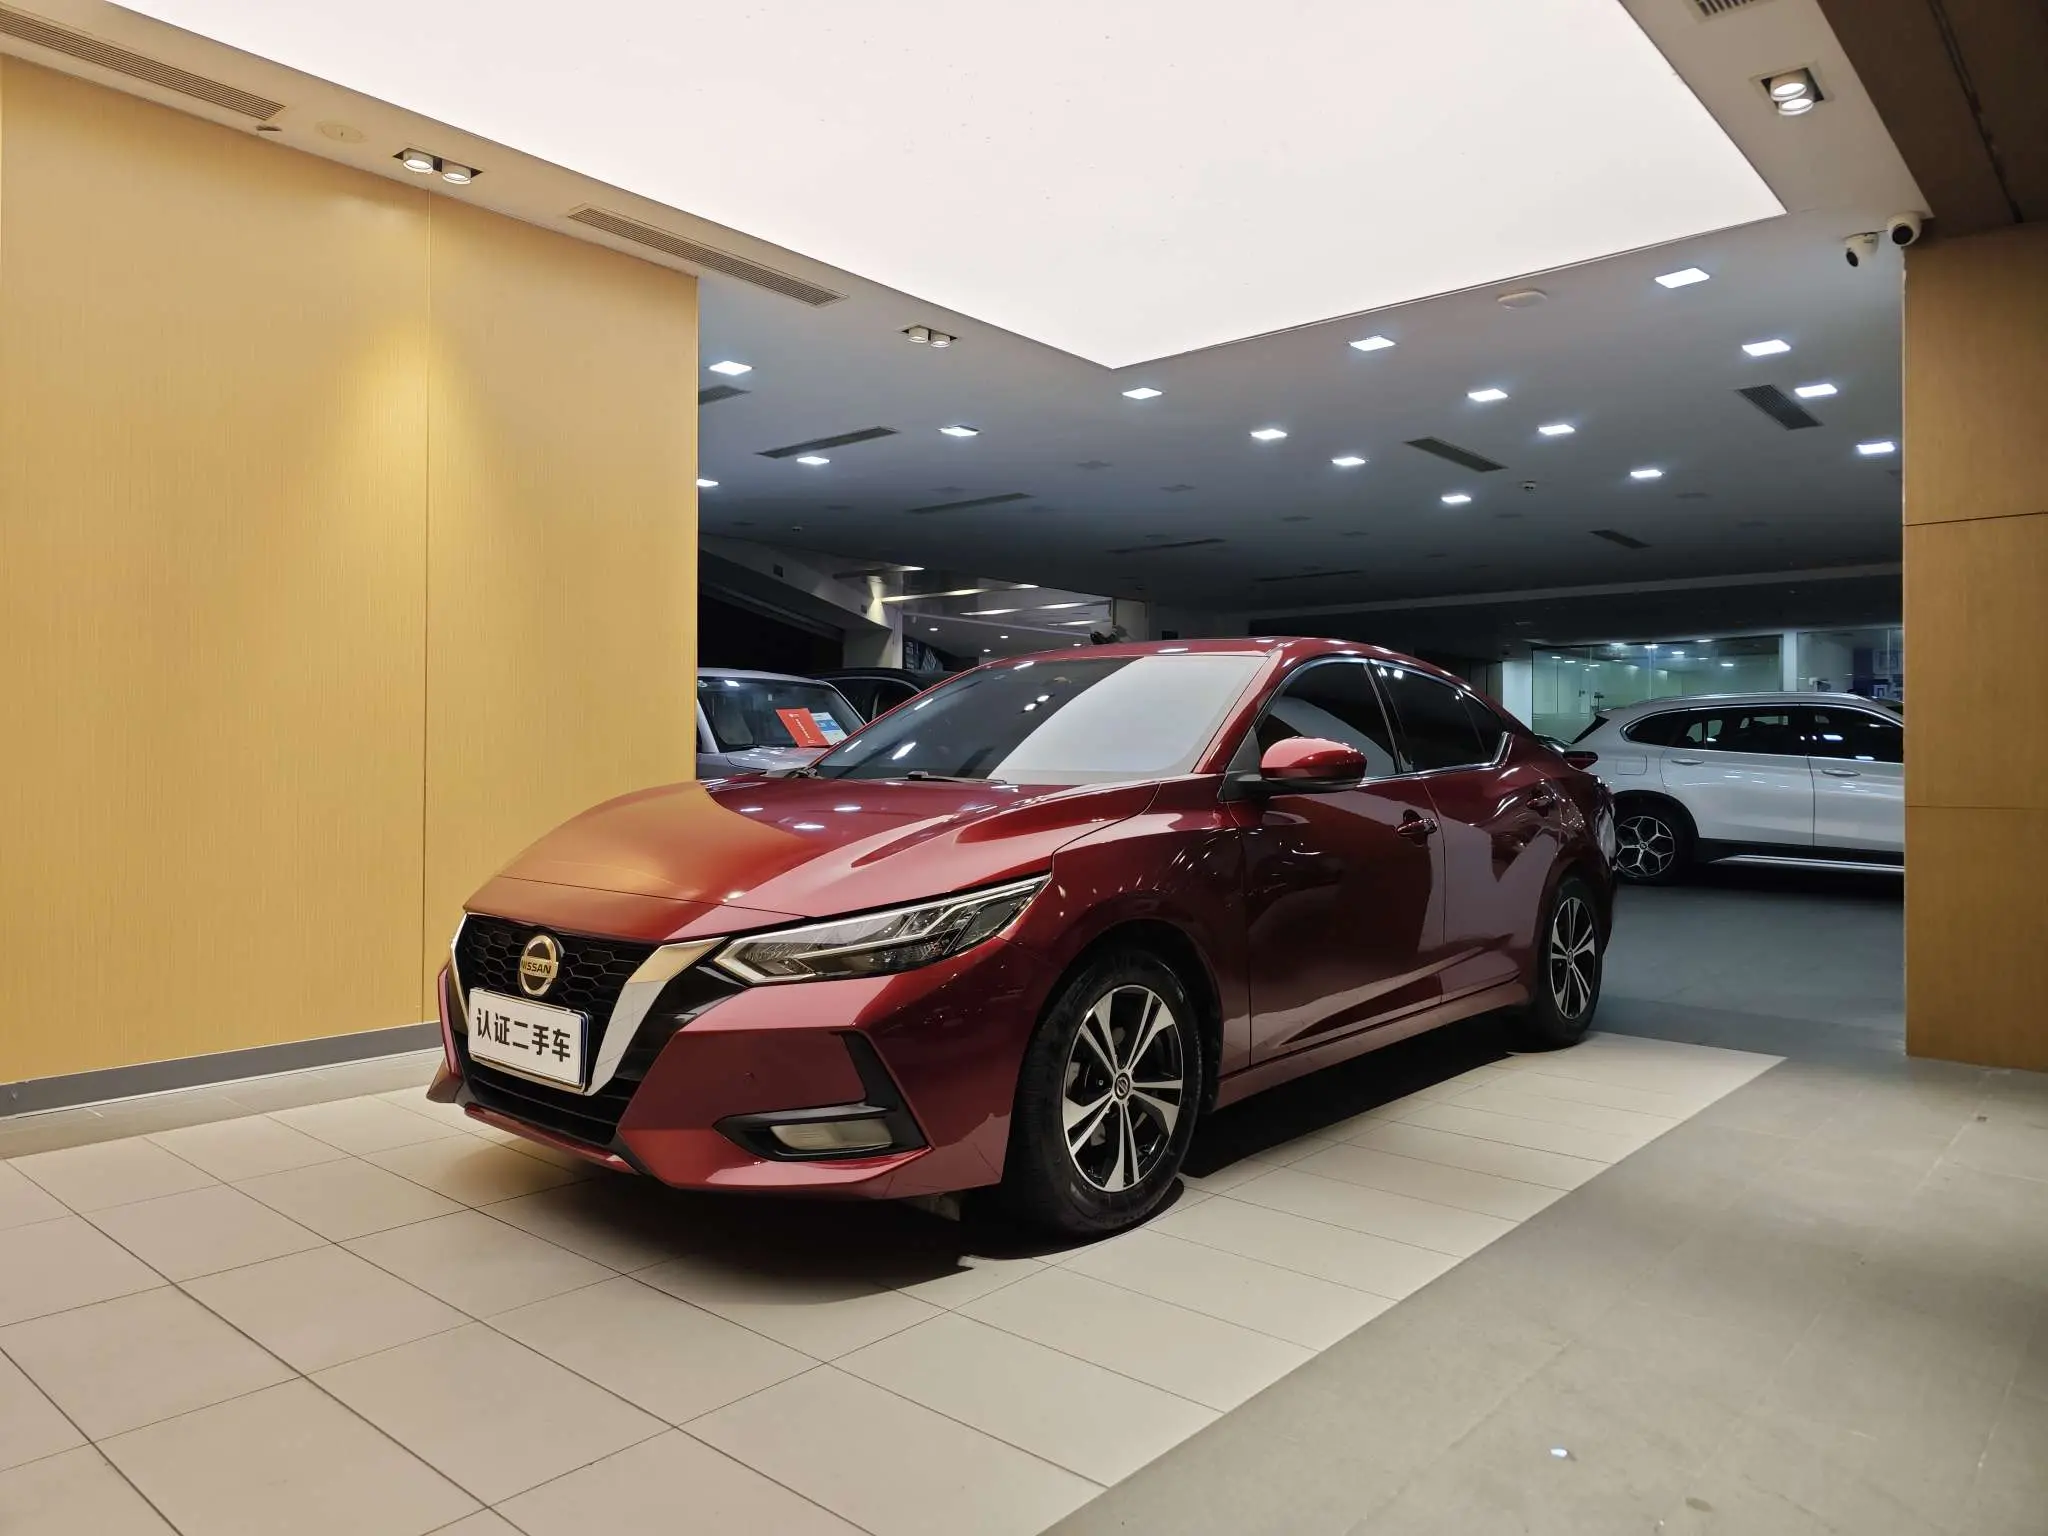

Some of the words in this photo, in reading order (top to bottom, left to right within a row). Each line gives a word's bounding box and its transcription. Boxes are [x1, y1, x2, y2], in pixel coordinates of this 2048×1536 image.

[521, 958, 552, 975] NISSAN
[476, 1007, 571, 1063] 认证二手车
